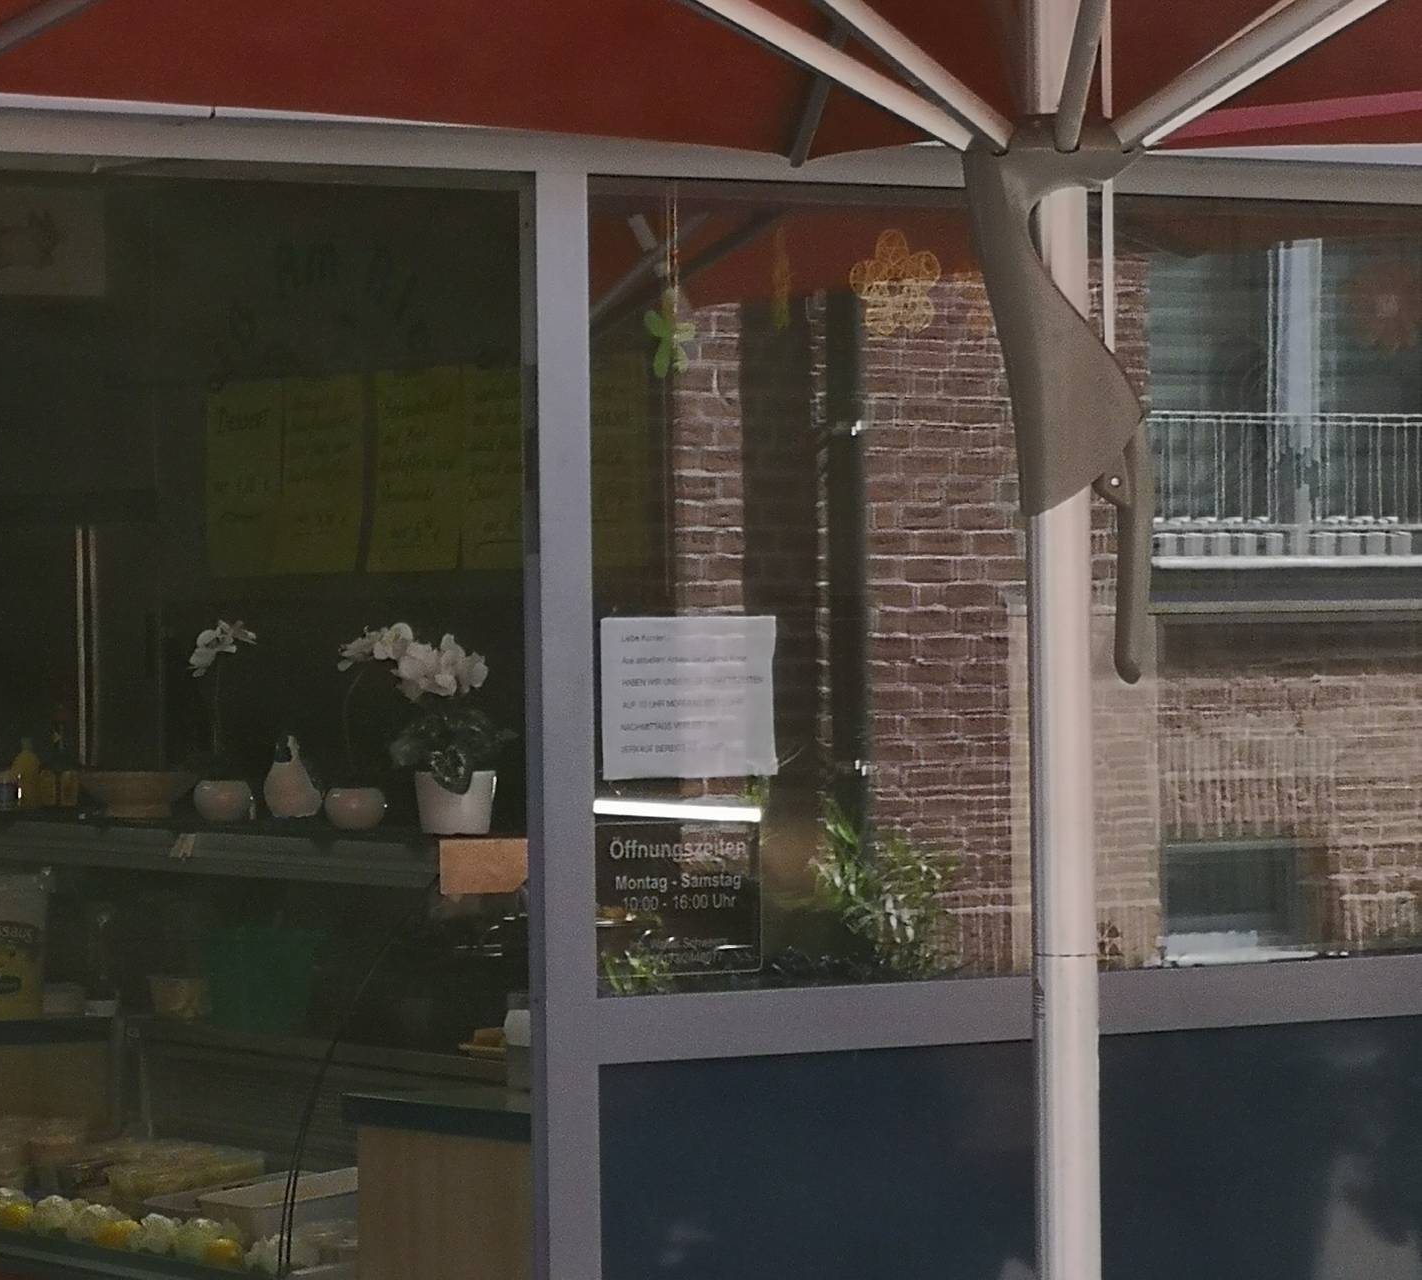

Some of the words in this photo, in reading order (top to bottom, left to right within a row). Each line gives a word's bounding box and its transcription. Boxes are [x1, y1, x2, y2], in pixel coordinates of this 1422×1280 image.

[609, 836, 747, 863] Öffnungszeiten
[615, 875, 668, 893] Montag
[681, 872, 742, 890] Samstag
[622, 896, 659, 912] 10:00
[672, 894, 709, 910] 16:00
[712, 893, 737, 909] Uhr
